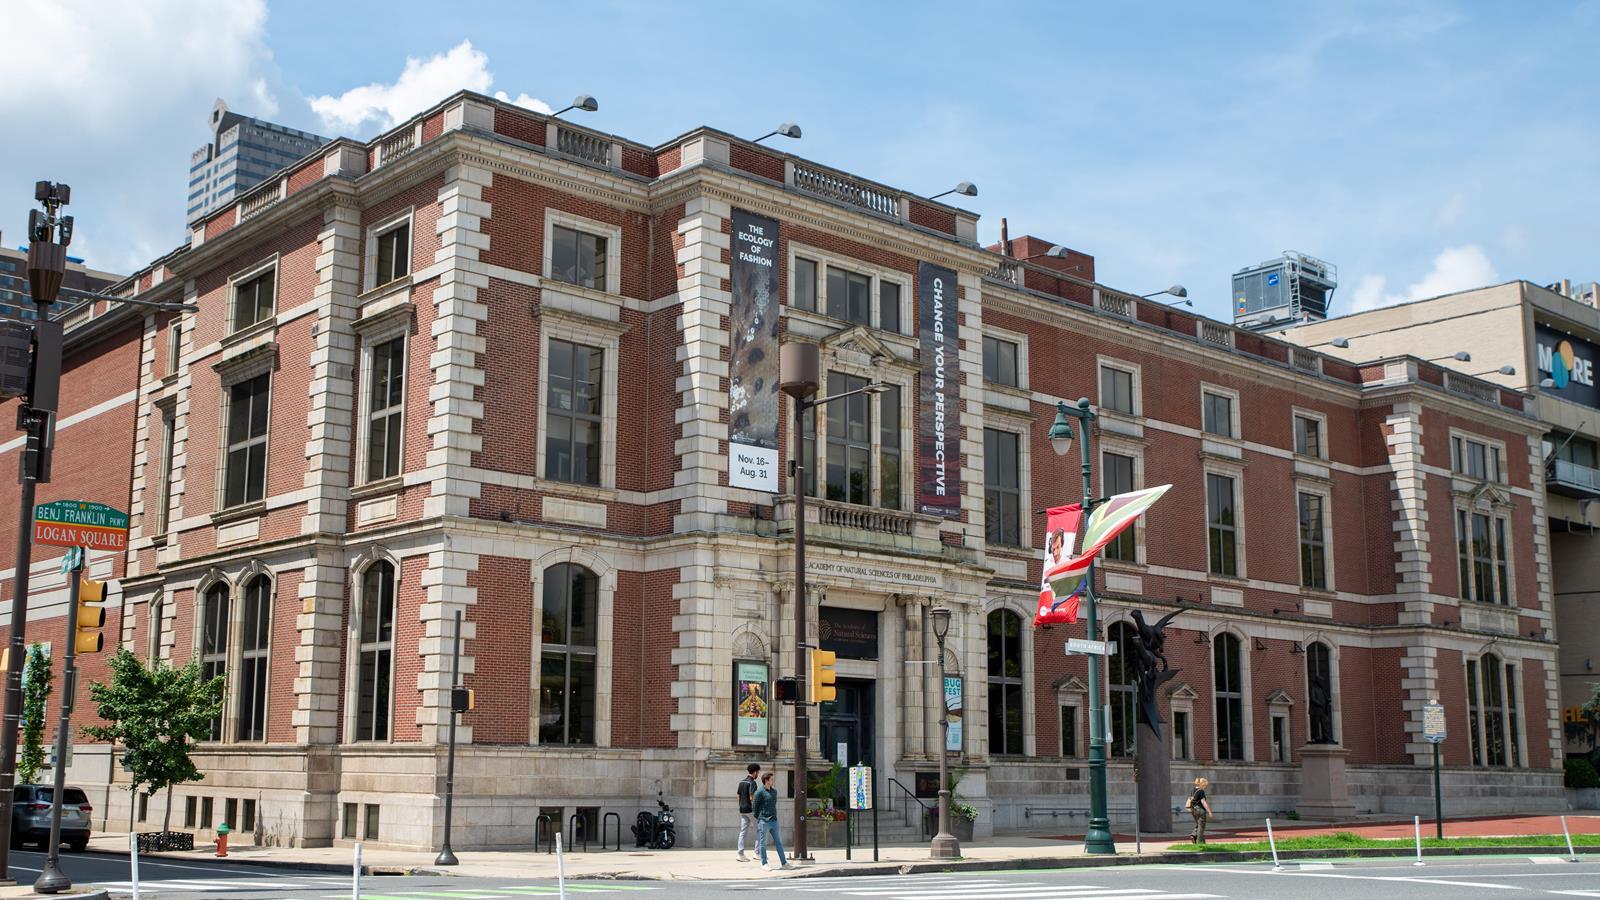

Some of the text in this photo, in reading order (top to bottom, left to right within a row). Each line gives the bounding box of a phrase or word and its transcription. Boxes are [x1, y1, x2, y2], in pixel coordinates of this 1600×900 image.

[749, 224, 764, 236] THE
[738, 232, 773, 247] ECOLOGY
[751, 245, 761, 254] OF
[740, 252, 772, 267] FASHION
[934, 278, 945, 496] CHANGE YOUR PERSPECTIVE
[738, 454, 754, 464] Nov.
[740, 467, 767, 478] Aug. 31
[38, 506, 125, 527] BENJ FRANKLIN PKWY
[37, 526, 124, 546] LOGAN SQUARE
[809, 562, 835, 571] ACADEMY
[844, 566, 868, 575] NATURAL
[869, 569, 893, 578] SCIENCES
[902, 573, 936, 583] PHILADELPHIA
[944, 679, 960, 687] BUG
